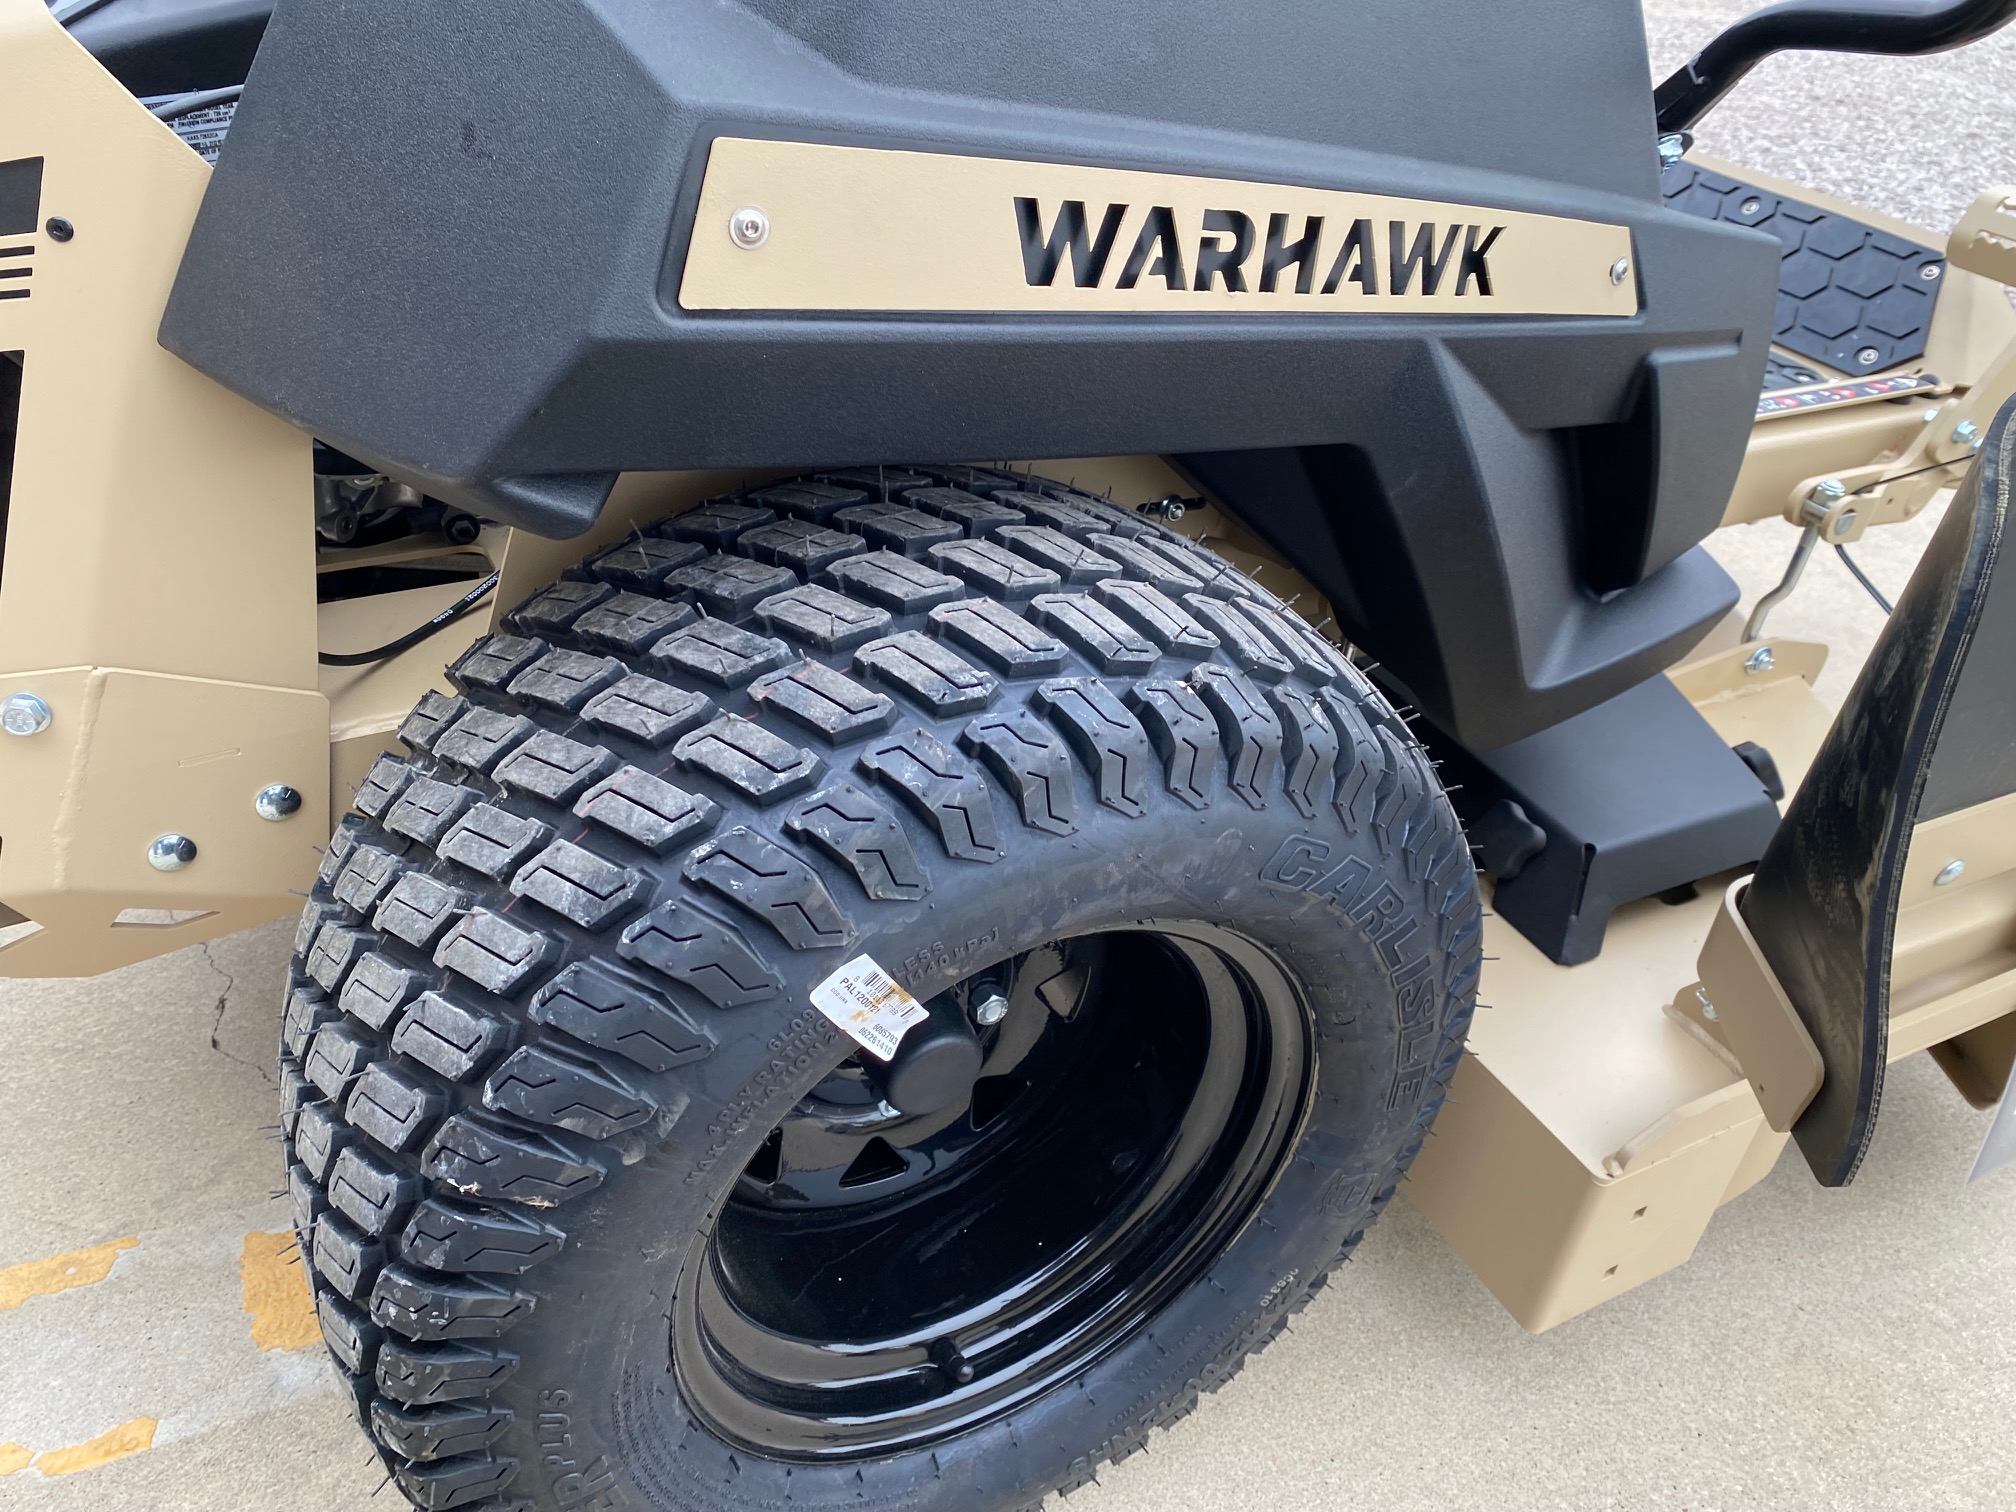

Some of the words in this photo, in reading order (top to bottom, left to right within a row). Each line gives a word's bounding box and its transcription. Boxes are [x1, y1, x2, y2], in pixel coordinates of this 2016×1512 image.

[200, 116, 228, 125] COMPLIANCE
[1013, 196, 1507, 297] WARHAWK
[840, 977, 881, 1015] PAL1200121
[1259, 834, 1439, 1111] CARLISLE
[718, 1086, 753, 1122] PLY
[755, 1018, 830, 1085] RATING
[725, 1042, 825, 1137] INFLATION
[538, 1389, 576, 1468] PLUS
[1107, 1389, 1157, 1427] SERVICE
[1067, 1425, 1136, 1475] NHS
